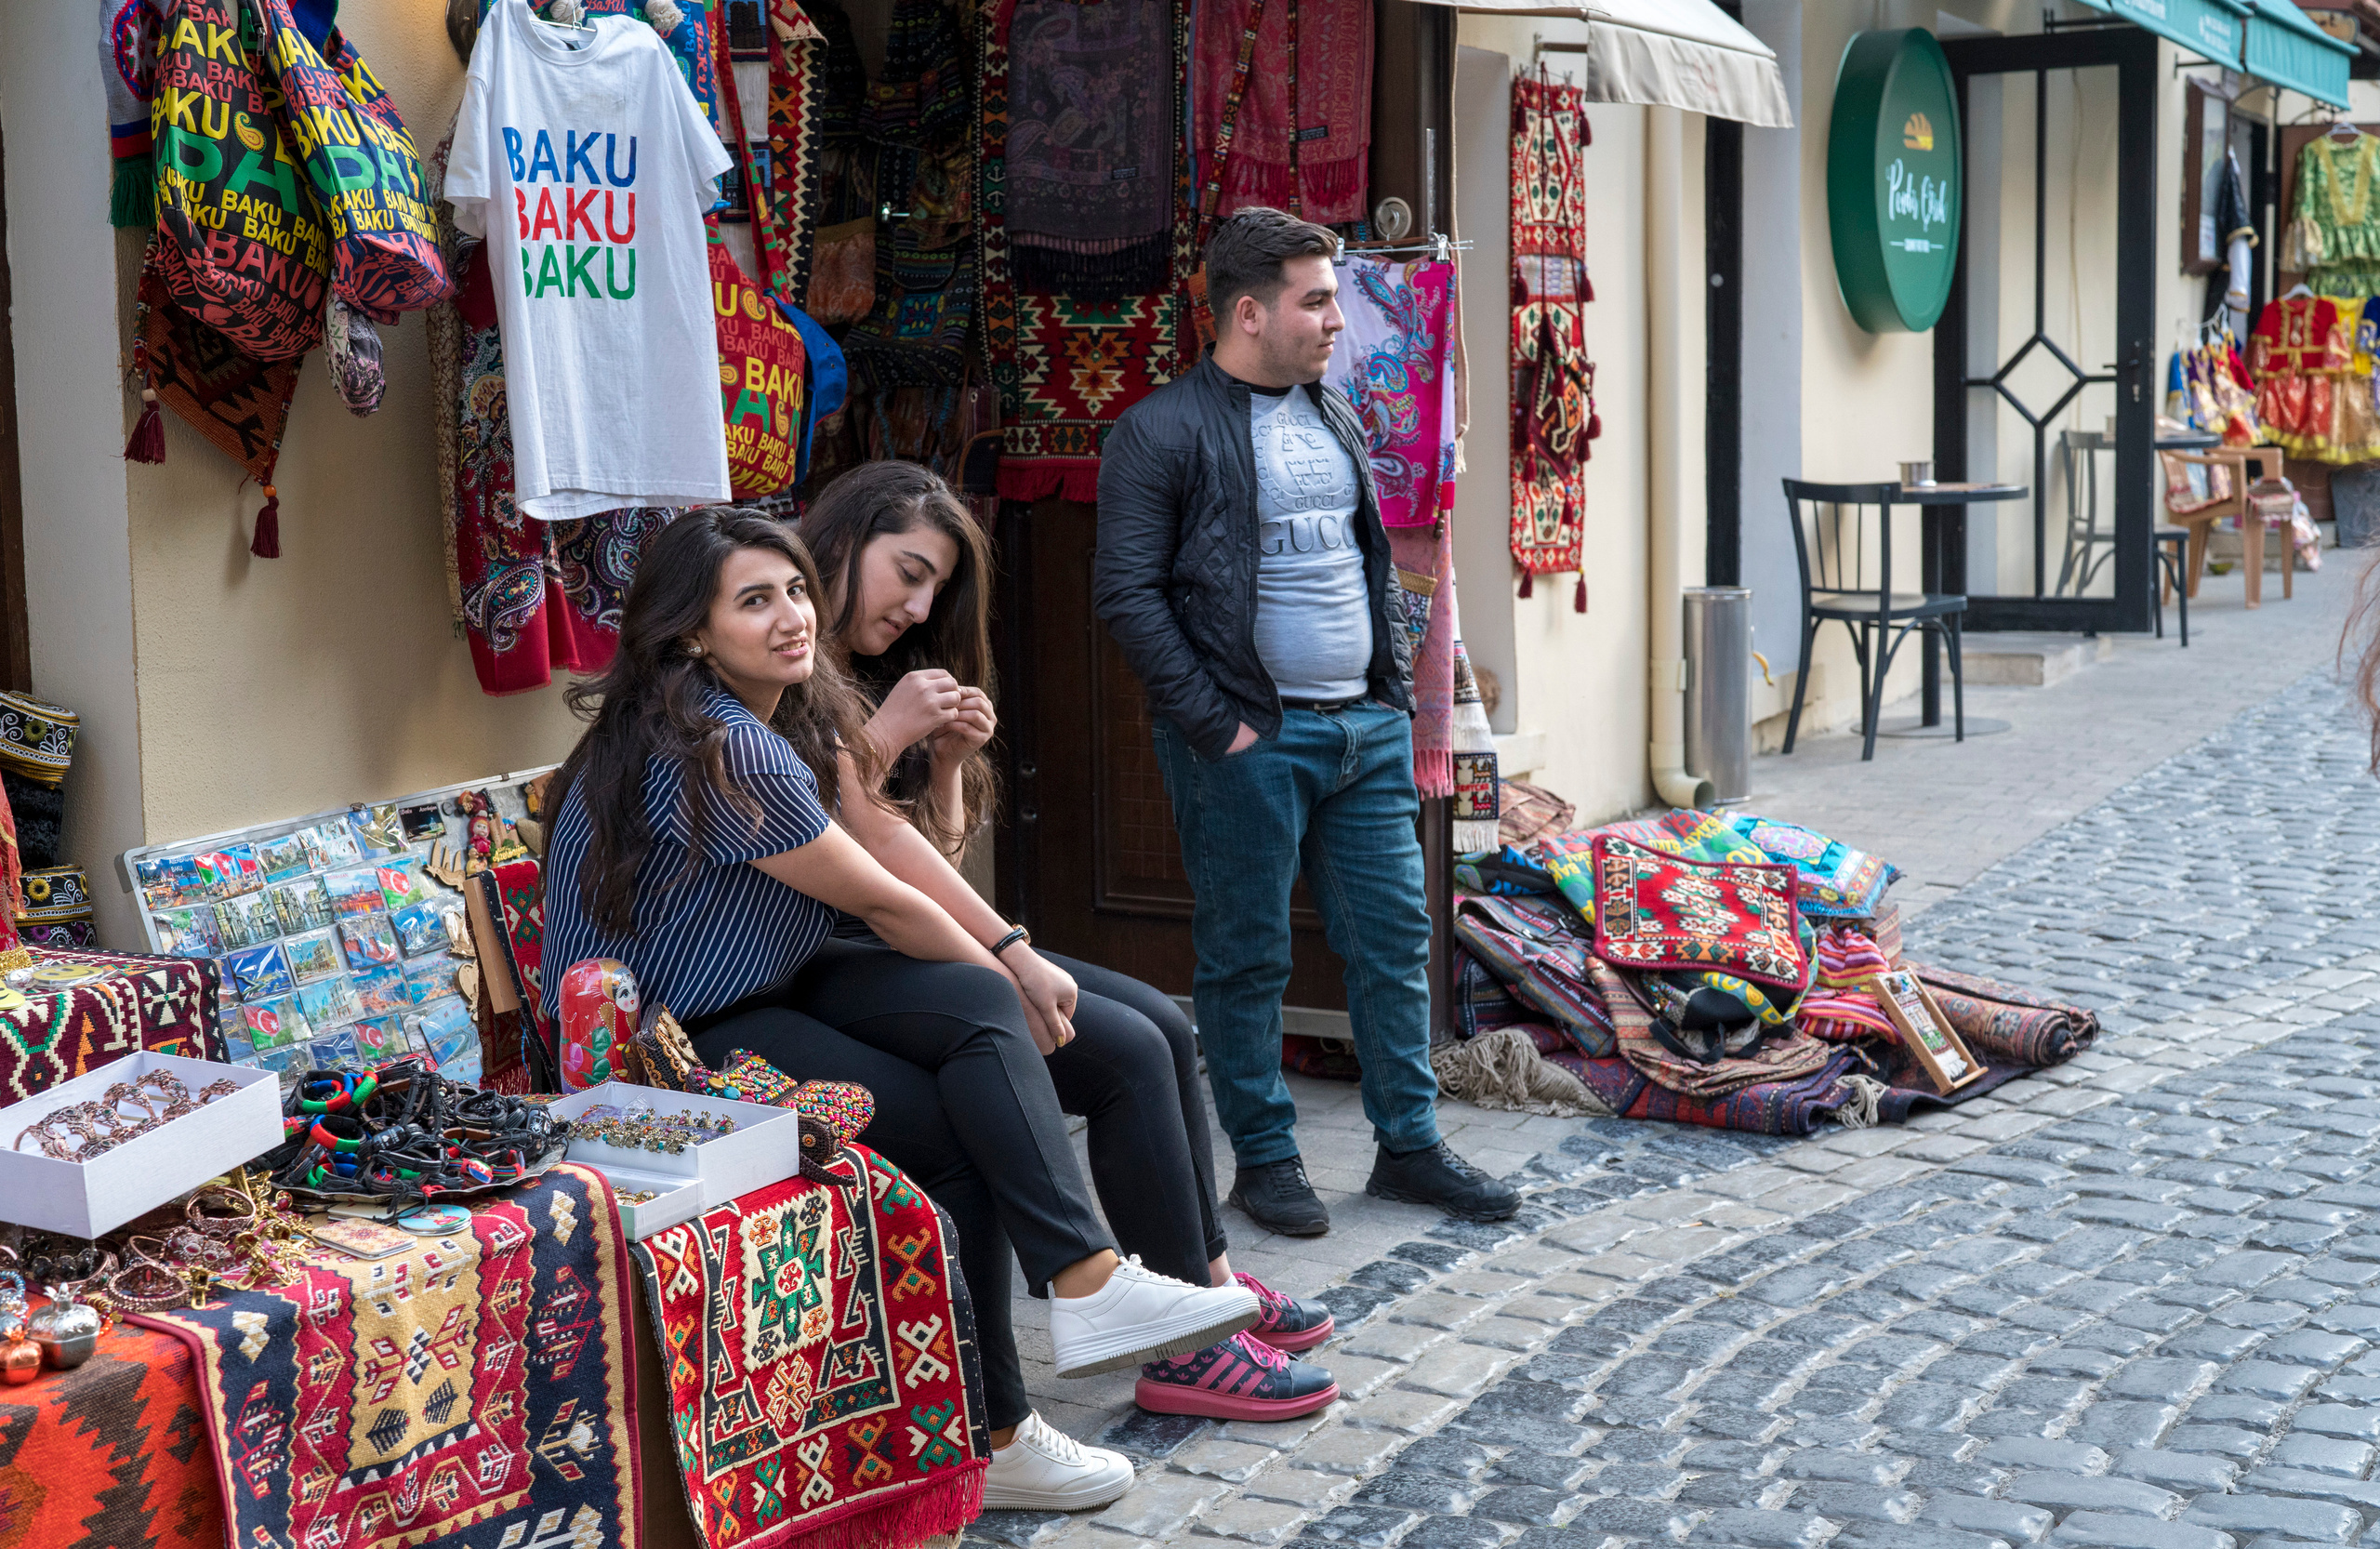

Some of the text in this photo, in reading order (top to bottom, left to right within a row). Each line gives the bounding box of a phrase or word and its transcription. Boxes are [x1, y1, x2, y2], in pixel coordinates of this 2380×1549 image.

[290, 105, 361, 162] BAKU
[502, 126, 637, 188] BAKU
[221, 189, 282, 226] BAKU
[351, 209, 394, 231] BAKU
[243, 216, 298, 256] BAKU
[165, 252, 195, 296] BAKU
[206, 229, 313, 298] BAKU
[231, 296, 273, 327] BAKU
[268, 324, 309, 351] BAKU
[266, 292, 299, 325] BAKU
[723, 335, 768, 360] BAKU
[750, 323, 787, 351] BAKU
[745, 355, 804, 412] BAKU
[1276, 412, 1312, 427] GUCCI
[727, 440, 788, 481] BAKU BAKU
[758, 431, 787, 459] BAKU
[1295, 495, 1334, 510] GUCCI
